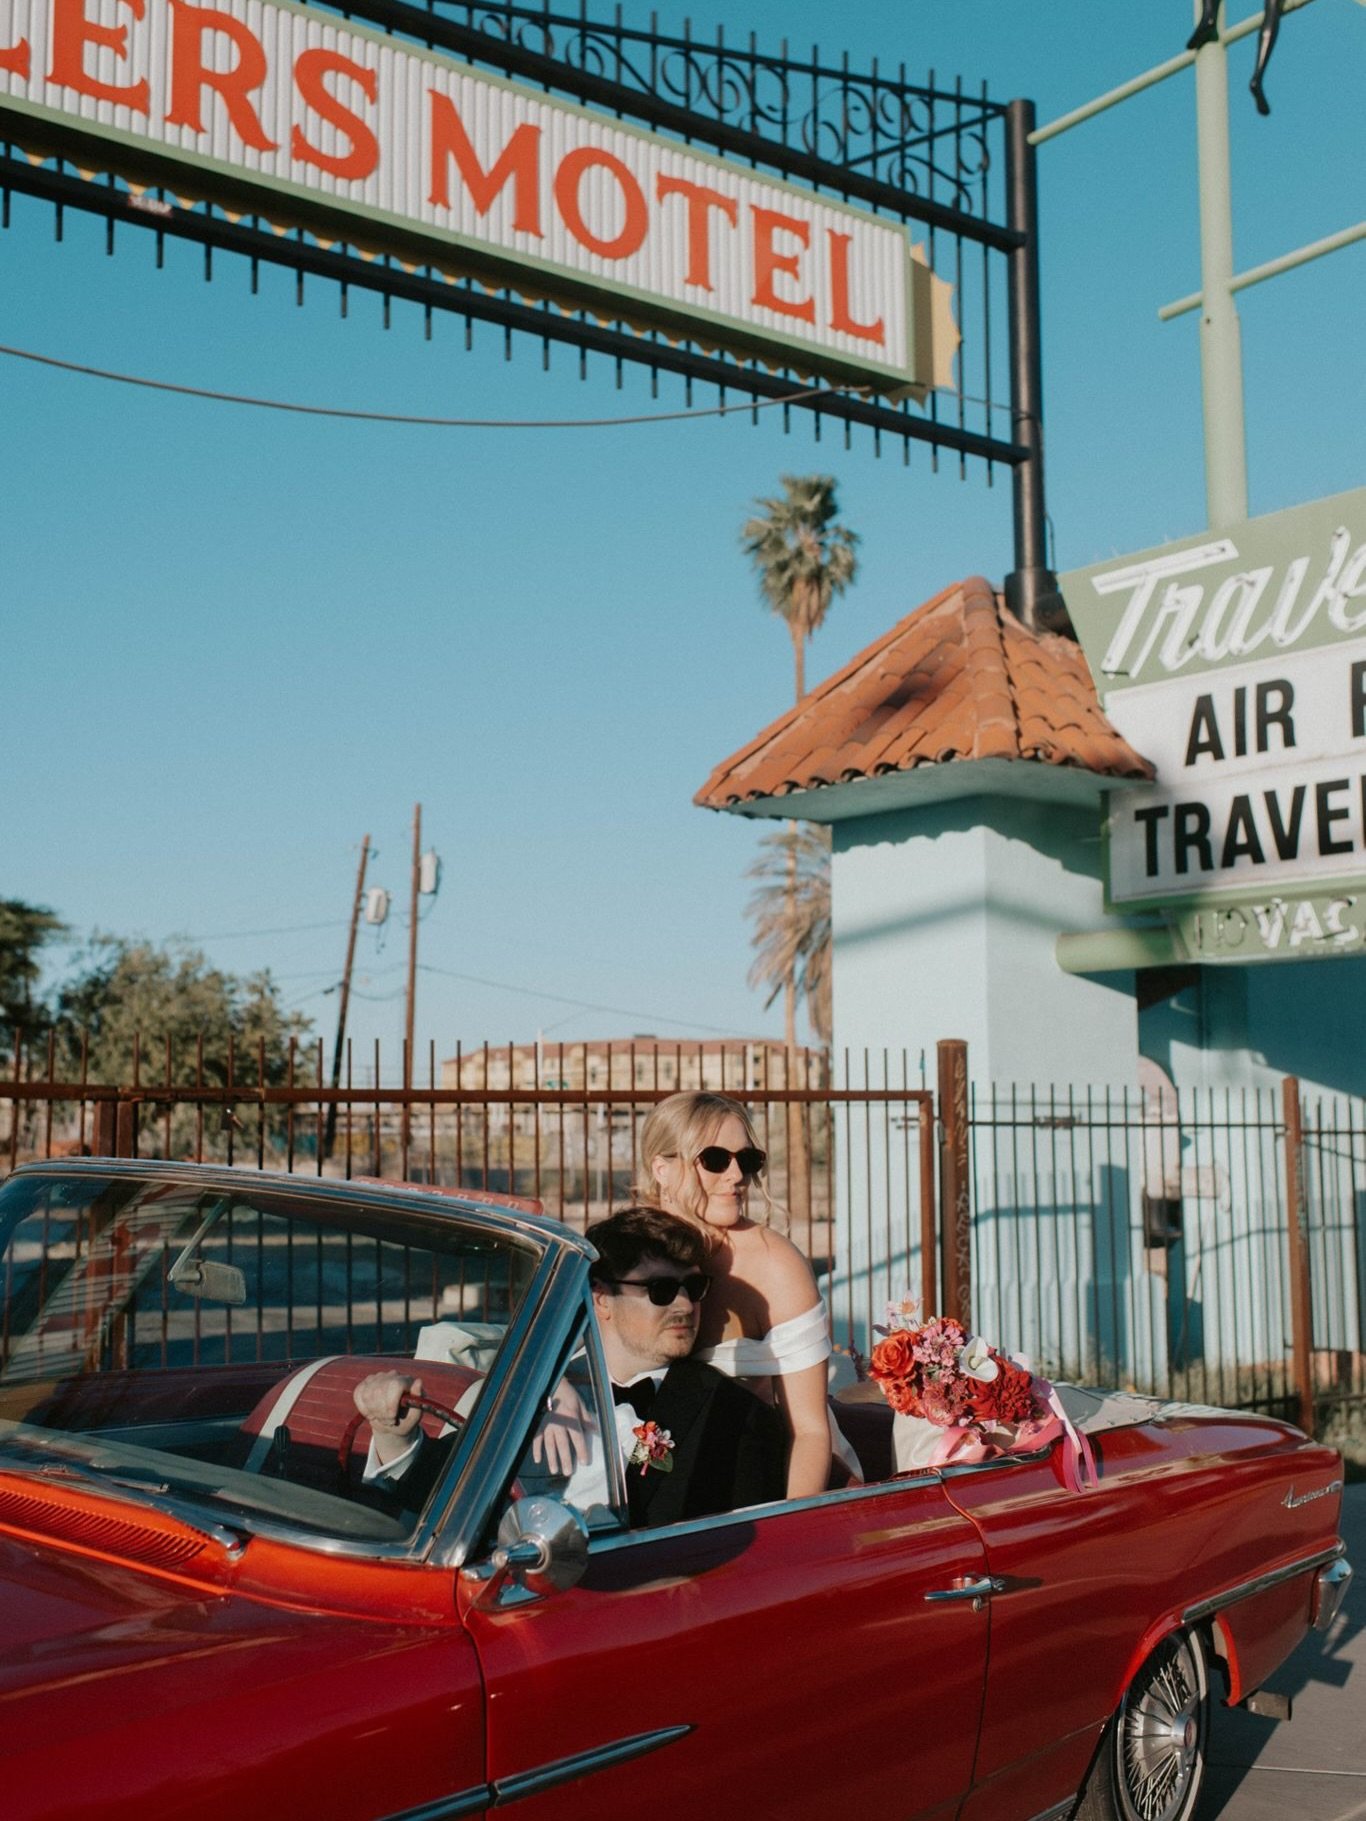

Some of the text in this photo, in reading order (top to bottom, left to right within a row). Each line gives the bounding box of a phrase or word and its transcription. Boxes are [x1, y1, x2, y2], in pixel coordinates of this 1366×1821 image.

[0, 0, 885, 346] ERS MOTEL
[1185, 679, 1296, 766] AIR
[1134, 774, 1366, 877] TRAVE
